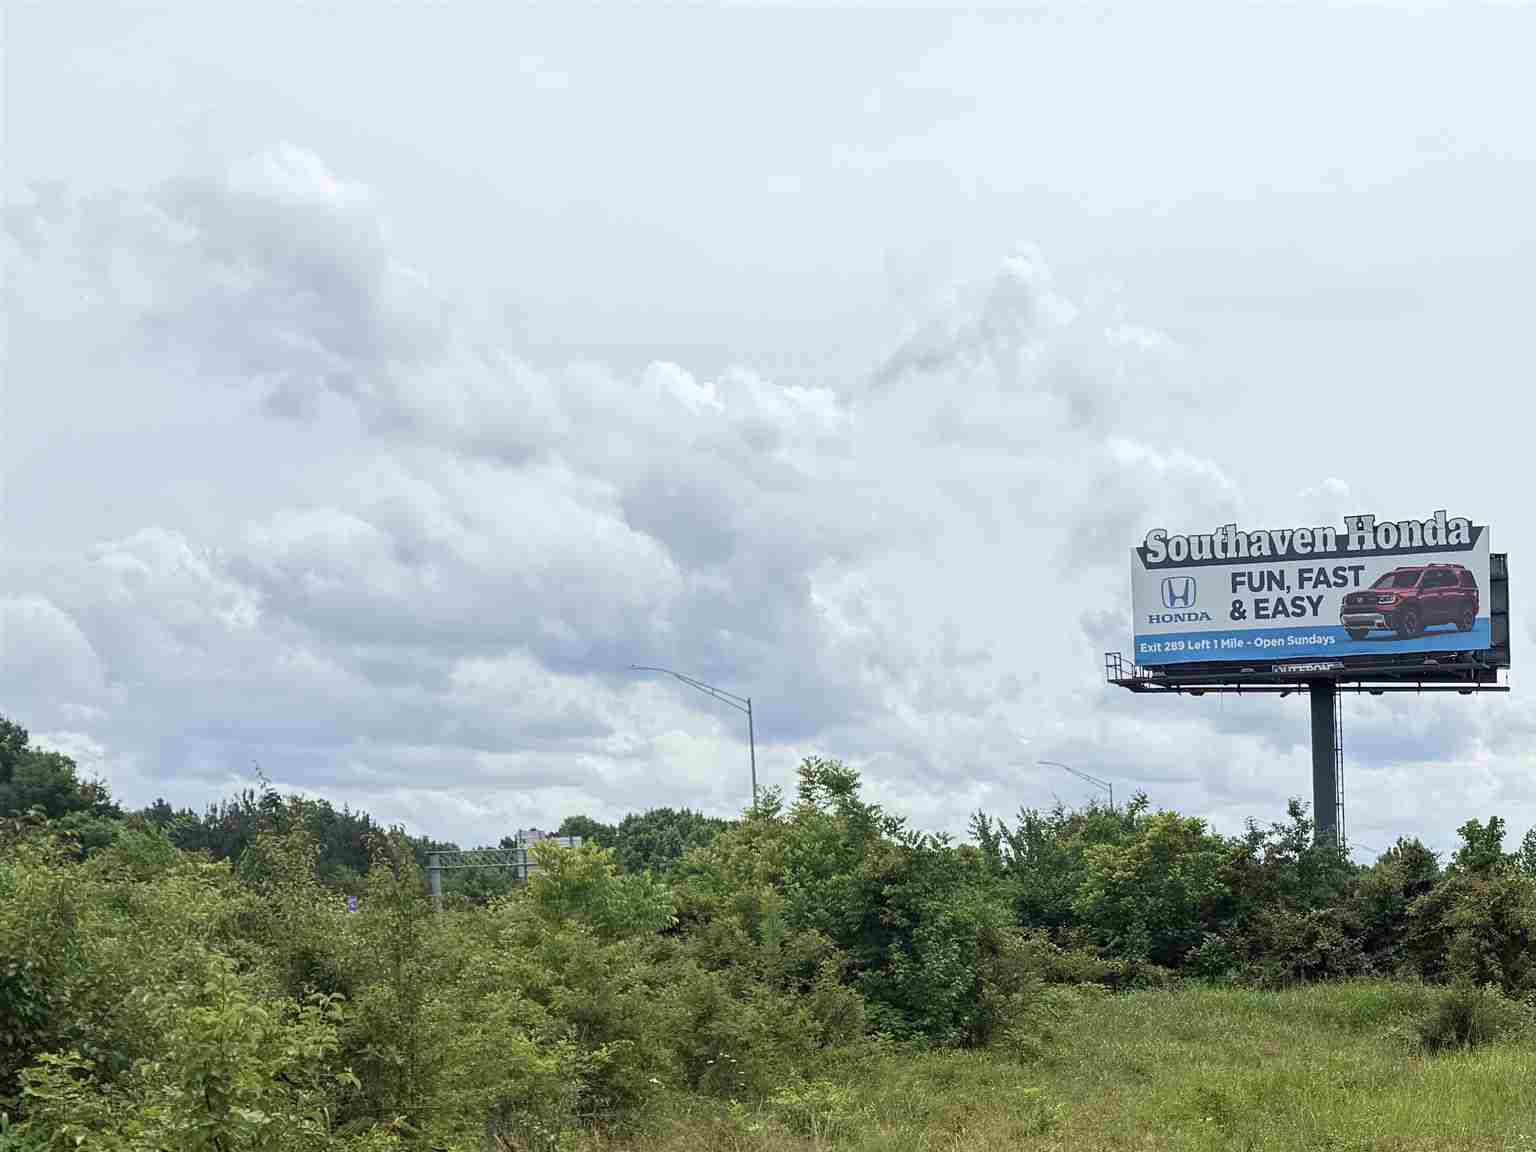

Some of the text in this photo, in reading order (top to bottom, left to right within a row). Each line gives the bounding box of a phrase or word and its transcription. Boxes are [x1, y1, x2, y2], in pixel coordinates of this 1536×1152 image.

[1146, 510, 1473, 563] Southaven Honda
[1231, 565, 1365, 594] FUN, FAST
[1148, 611, 1212, 624] HONDA
[1230, 595, 1324, 621] & EASY
[1140, 642, 1162, 653] Exit
[1187, 639, 1210, 650] Left
[1212, 639, 1218, 649] 1
[1221, 637, 1243, 649] Mile
[1253, 636, 1285, 649] Open
[1287, 633, 1336, 647] Sundays
